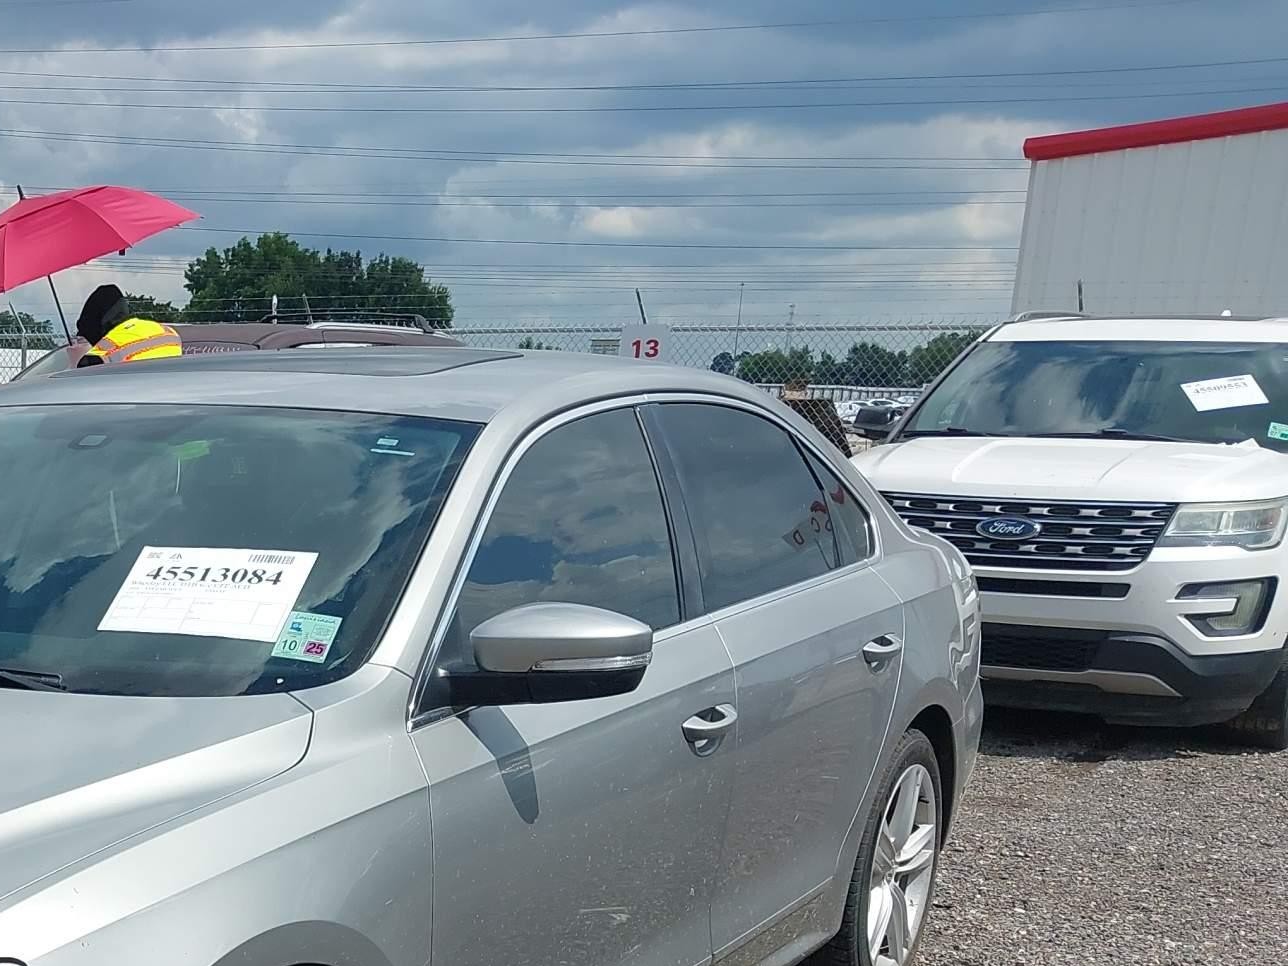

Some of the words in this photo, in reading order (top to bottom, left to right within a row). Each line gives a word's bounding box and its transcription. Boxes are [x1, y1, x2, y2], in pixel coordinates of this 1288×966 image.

[631, 339, 660, 358] 13
[988, 520, 1025, 534] Ford
[145, 565, 284, 586] 45513084
[281, 639, 298, 651] 10
[306, 642, 325, 655] 25
